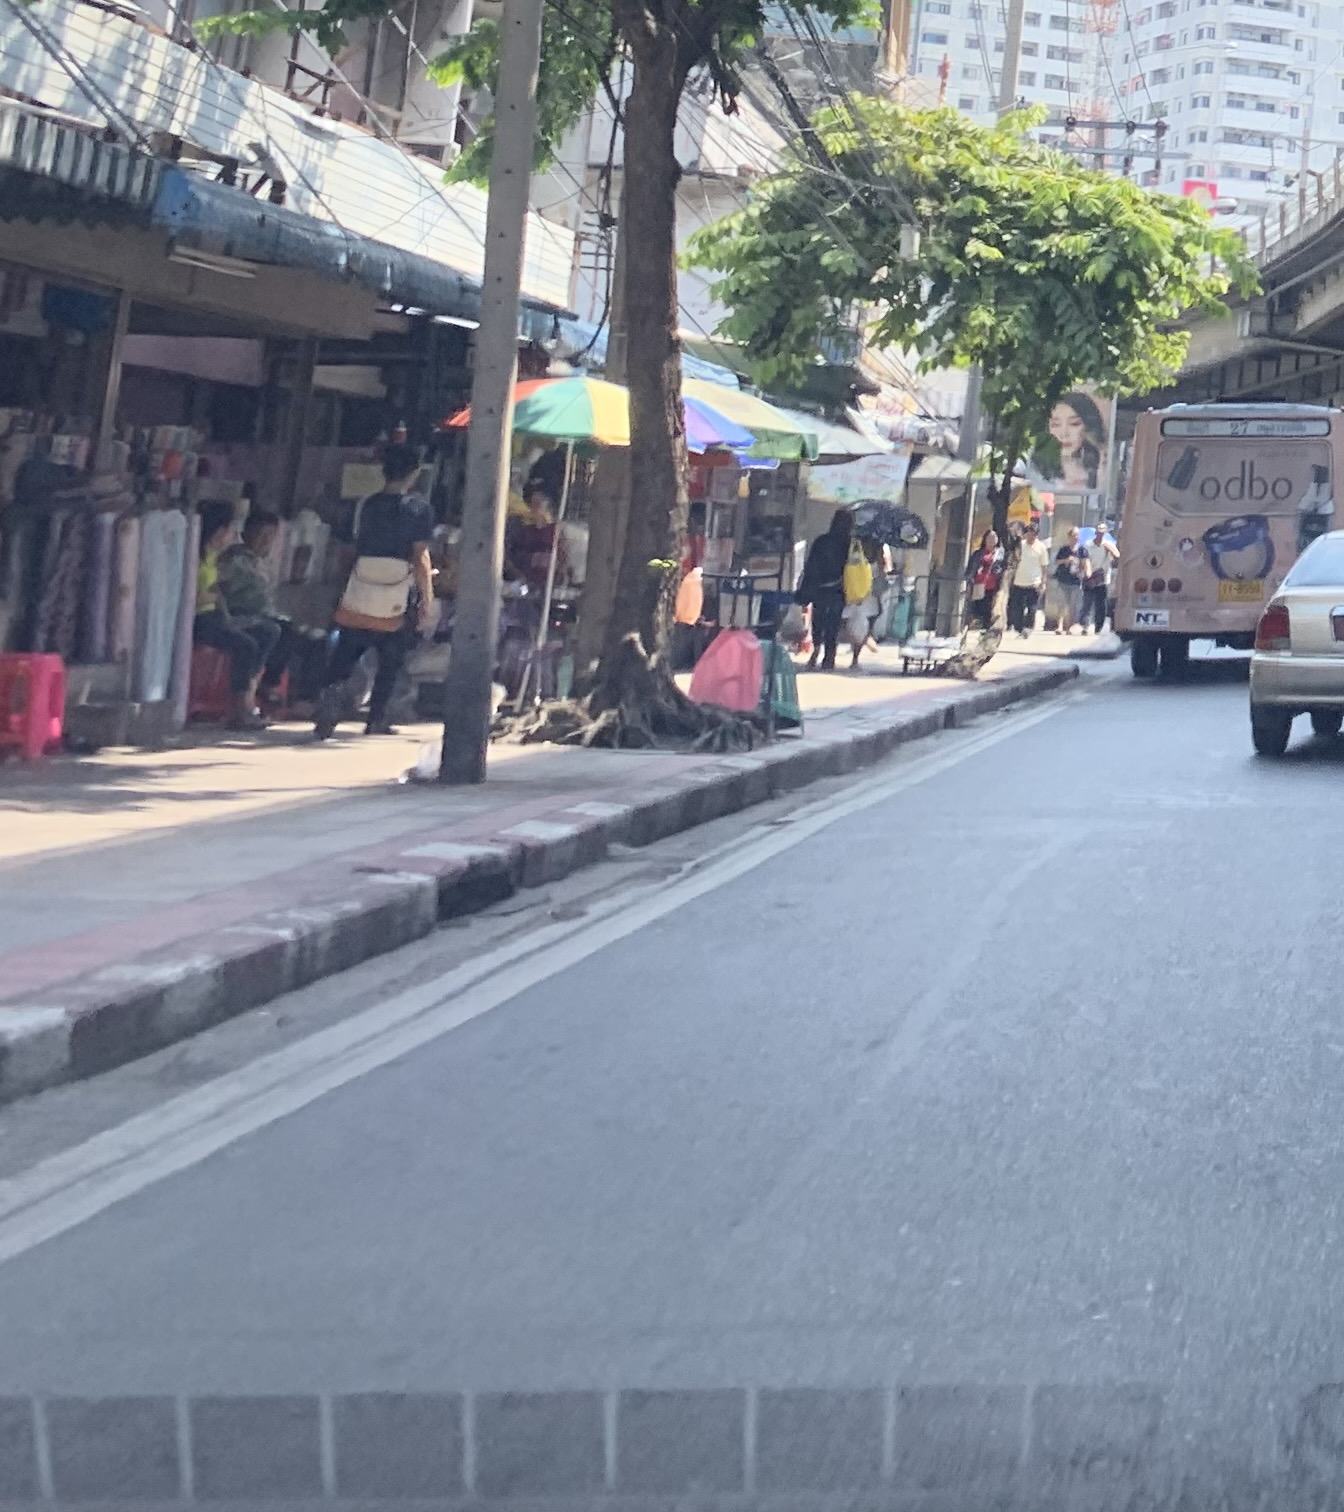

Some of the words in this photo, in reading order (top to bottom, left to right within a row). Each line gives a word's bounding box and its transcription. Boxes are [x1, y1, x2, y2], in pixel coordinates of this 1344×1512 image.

[1230, 422, 1249, 434] 27
[1201, 460, 1292, 500] odbo
[1136, 612, 1162, 623] NT
